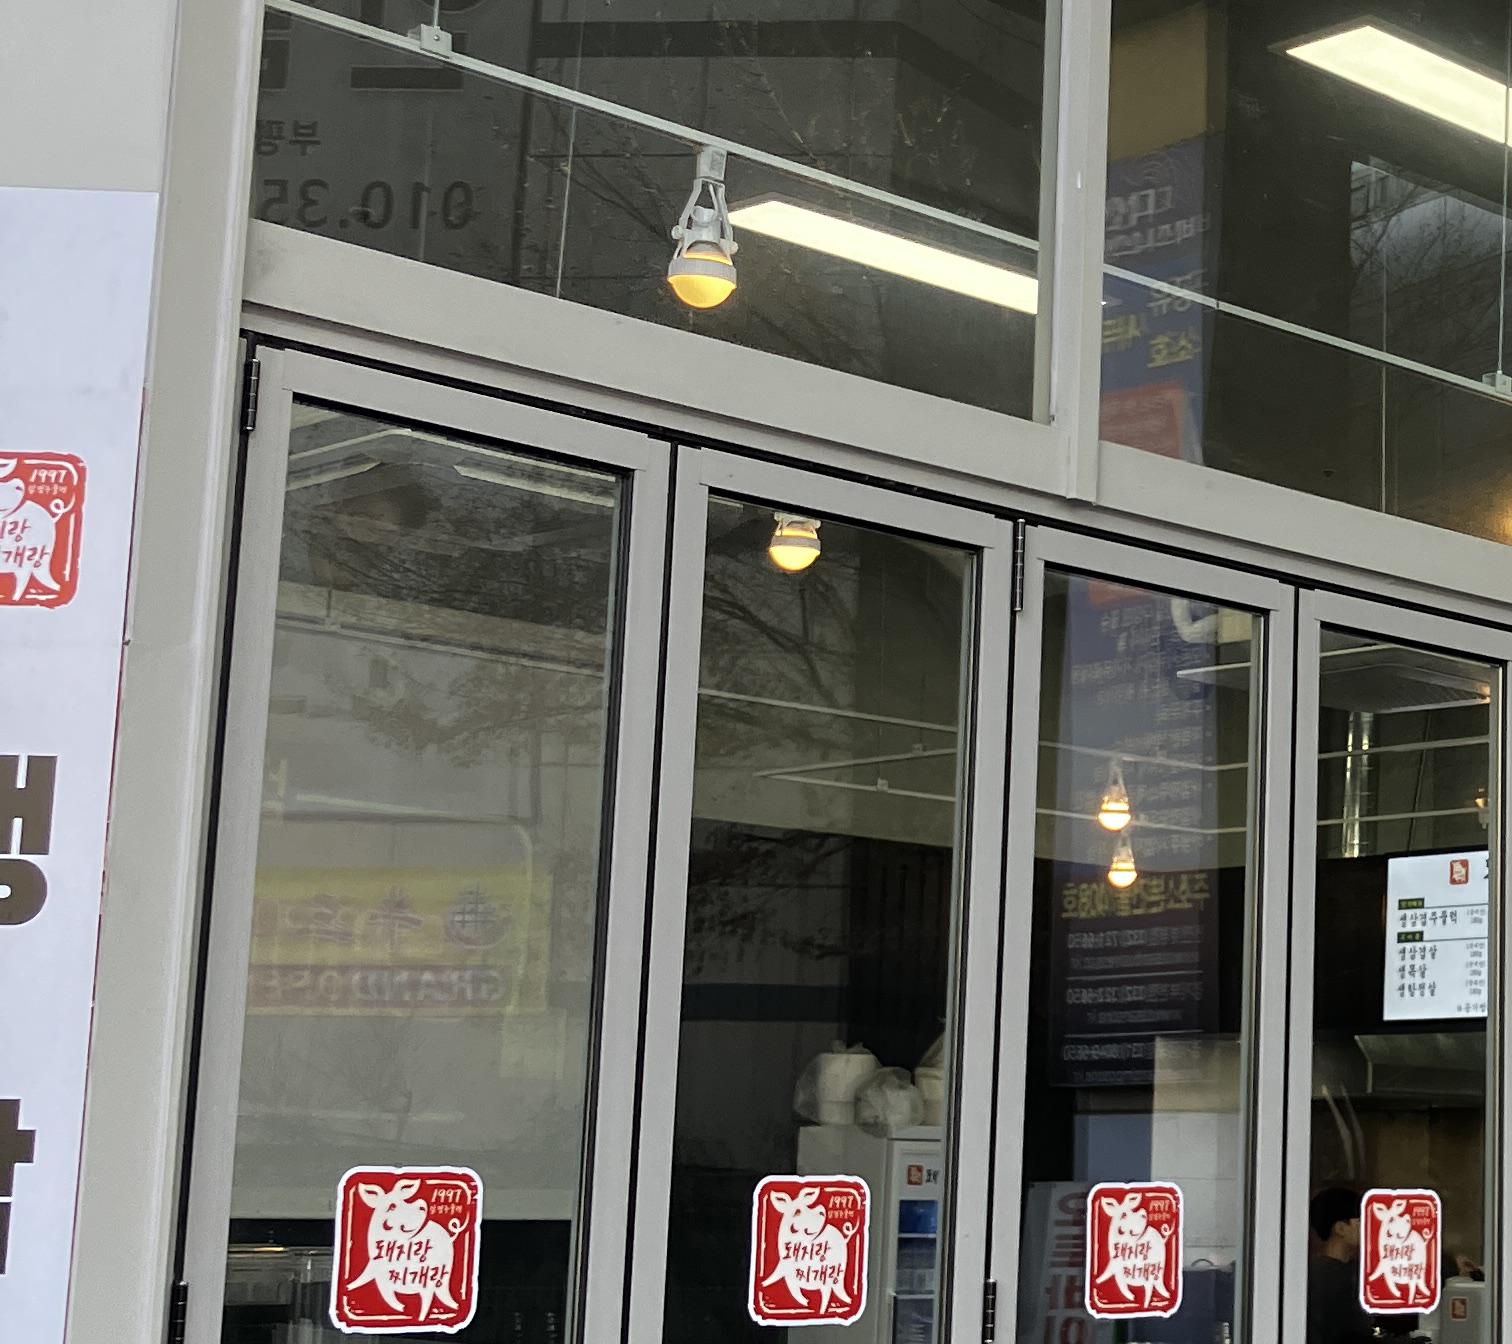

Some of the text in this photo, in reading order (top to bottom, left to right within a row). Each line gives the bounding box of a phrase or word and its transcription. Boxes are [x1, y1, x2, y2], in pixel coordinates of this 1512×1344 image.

[29, 468, 67, 483] 1997
[0, 518, 31, 542] 랑
[0, 545, 50, 568] 개랑
[431, 1187, 462, 1202] 1997
[828, 1194, 855, 1210] 1997
[373, 1239, 431, 1262] 돼지랑
[783, 1240, 832, 1262] 돼지랑
[1113, 1241, 1153, 1261] 돼지랑
[1382, 1244, 1416, 1263] 돼지랑
[389, 1265, 449, 1289] 찌개랑
[795, 1264, 844, 1286] 찌개랑
[1123, 1260, 1163, 1281] 찌개랑
[1391, 1263, 1426, 1281] 찌개랑
